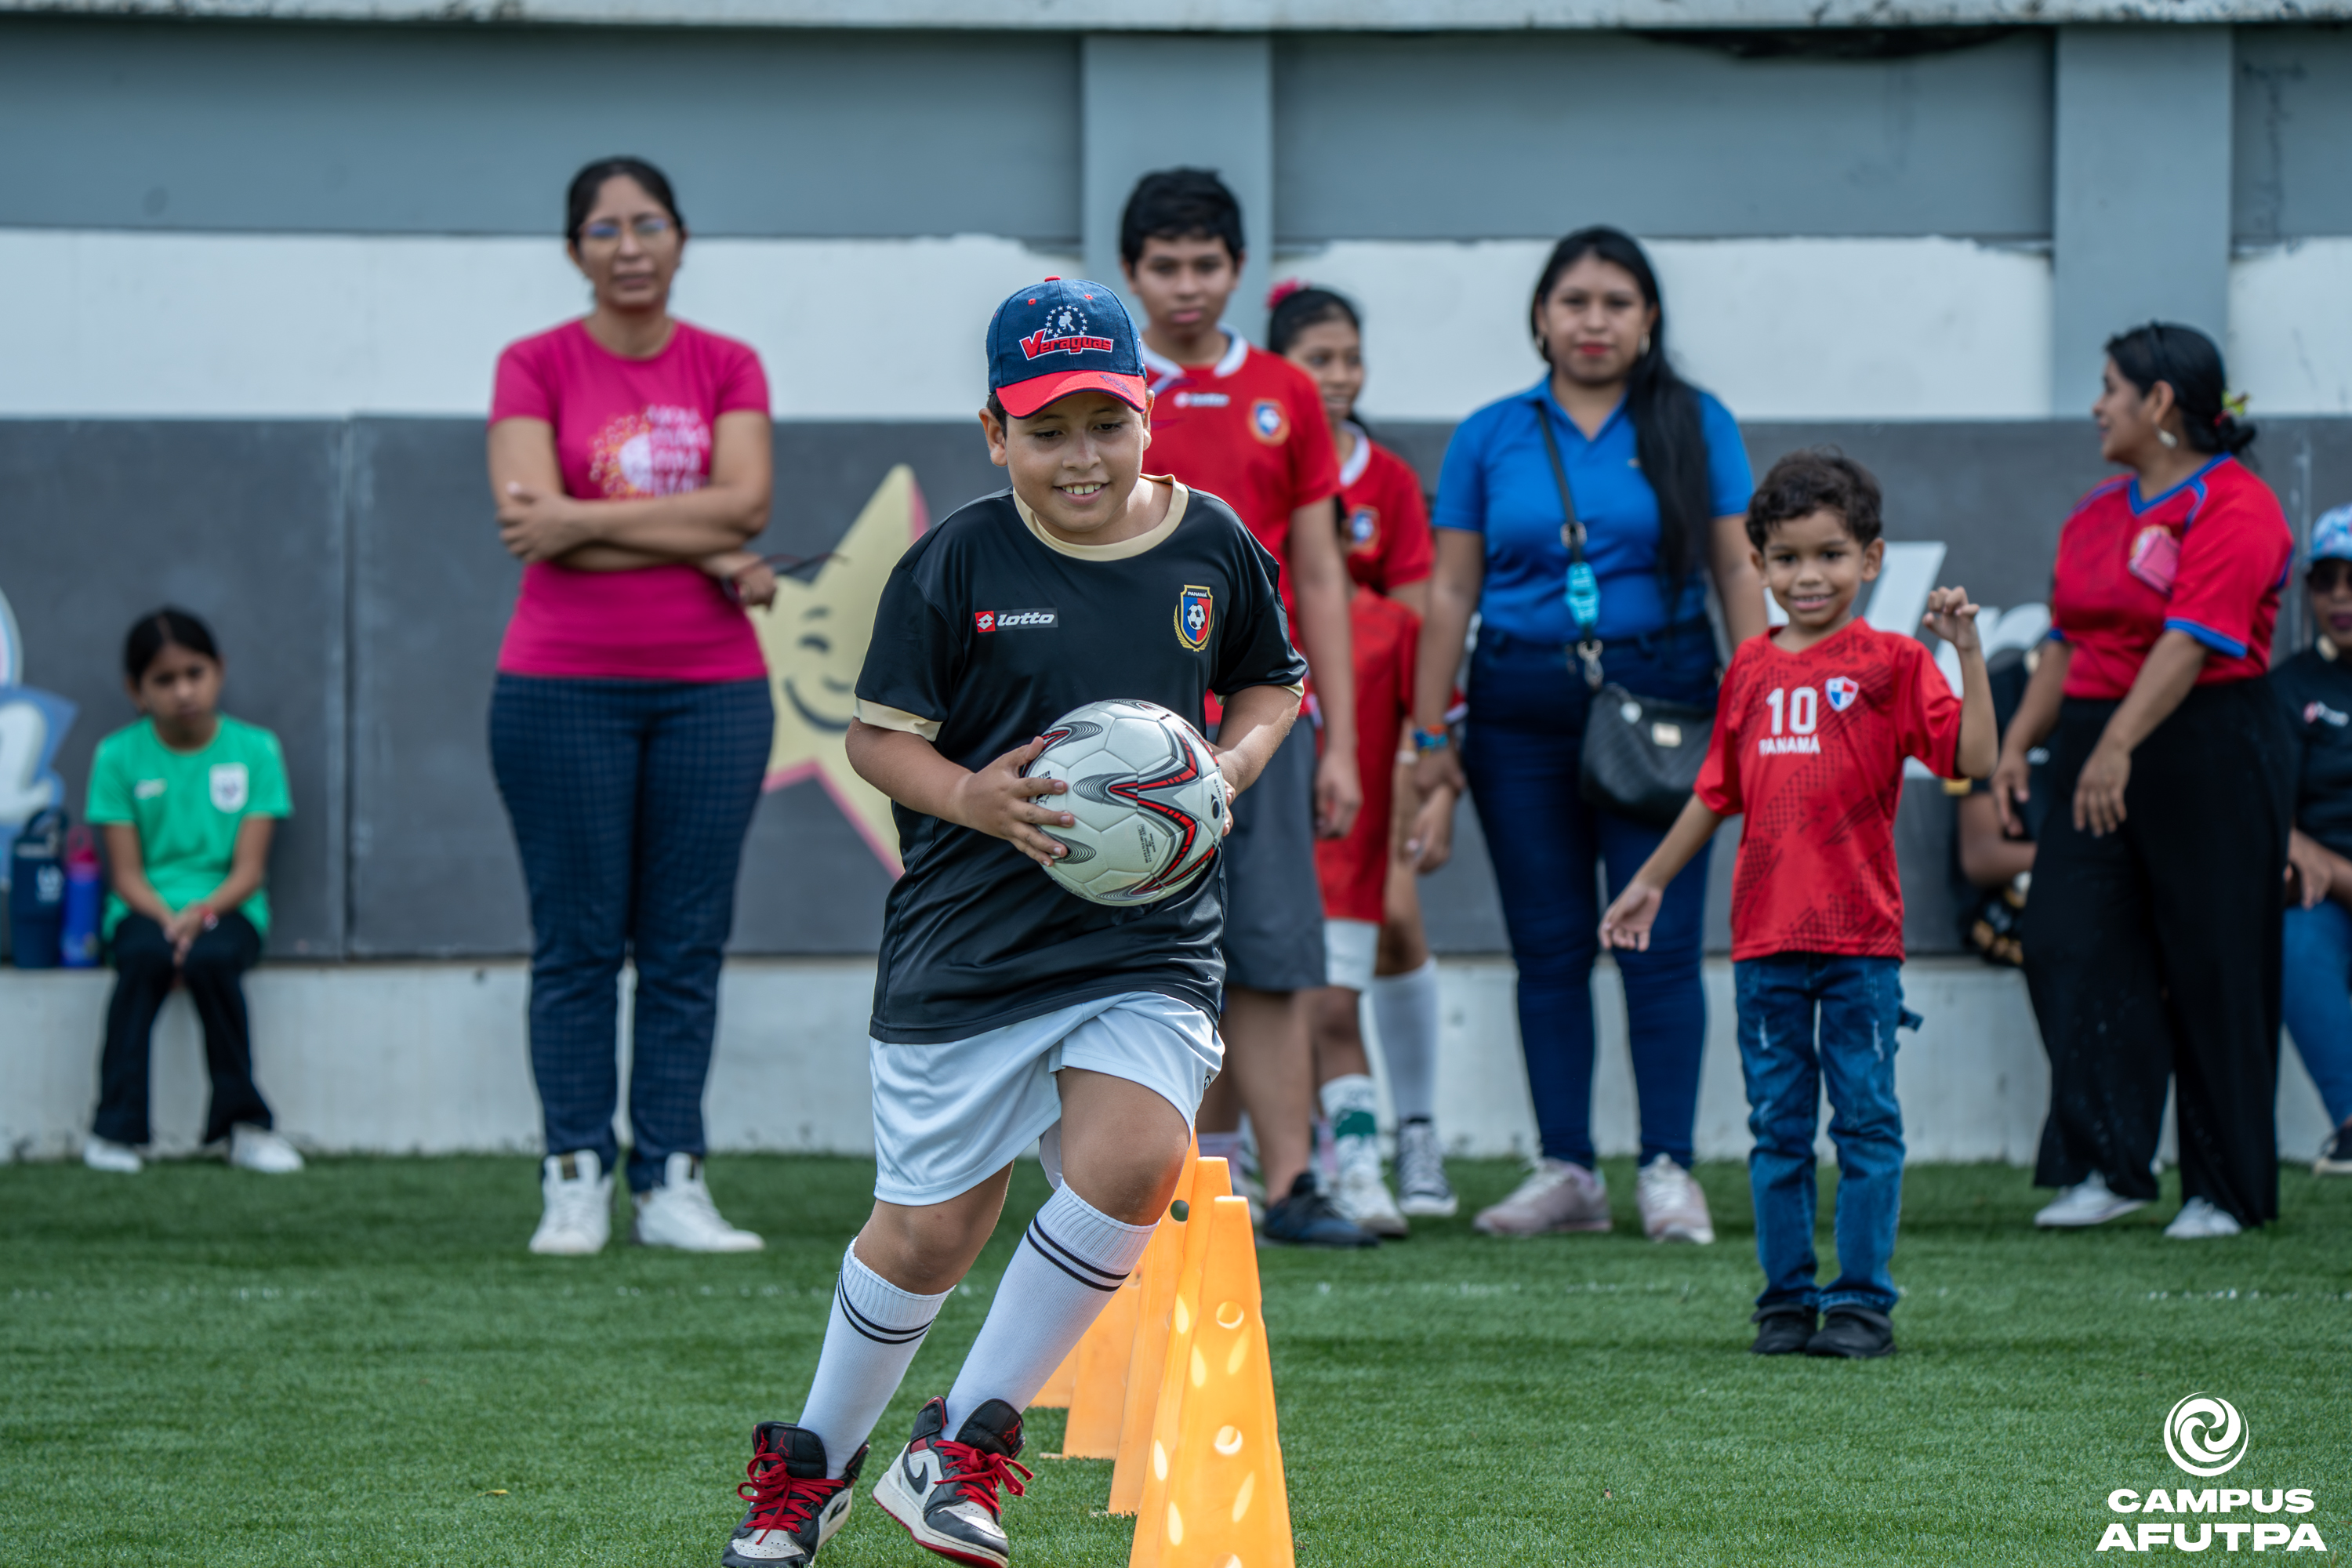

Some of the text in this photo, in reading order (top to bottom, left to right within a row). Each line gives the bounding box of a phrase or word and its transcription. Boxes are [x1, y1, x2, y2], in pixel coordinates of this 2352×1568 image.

[1020, 328, 1113, 360] Veraguas
[996, 612, 1055, 626] lotto
[1766, 686, 1818, 735] 10
